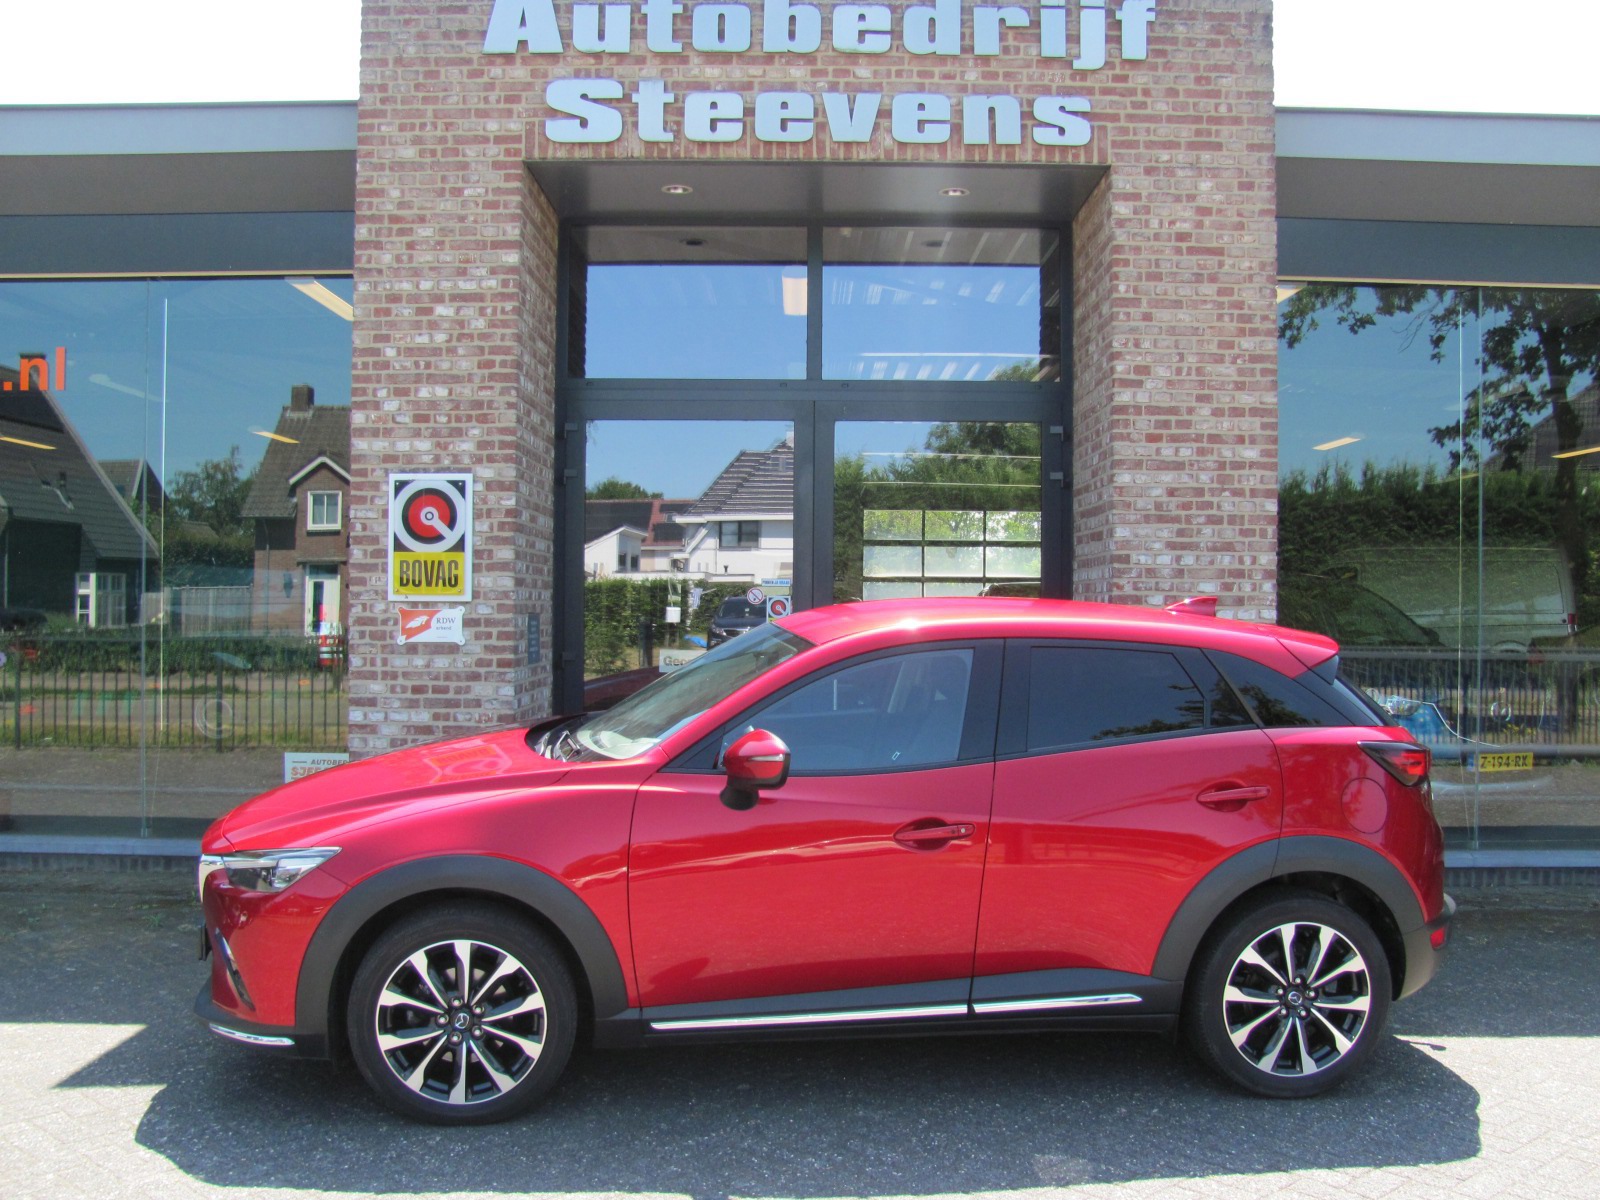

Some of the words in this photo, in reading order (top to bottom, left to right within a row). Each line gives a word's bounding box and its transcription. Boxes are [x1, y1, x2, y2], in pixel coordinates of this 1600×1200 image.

[482, 0, 1156, 71] Autobedrijf
[545, 78, 1092, 146] Steevens
[3, 346, 66, 391] .nl
[399, 559, 459, 588] BOVAG
[436, 617, 456, 625] RDW
